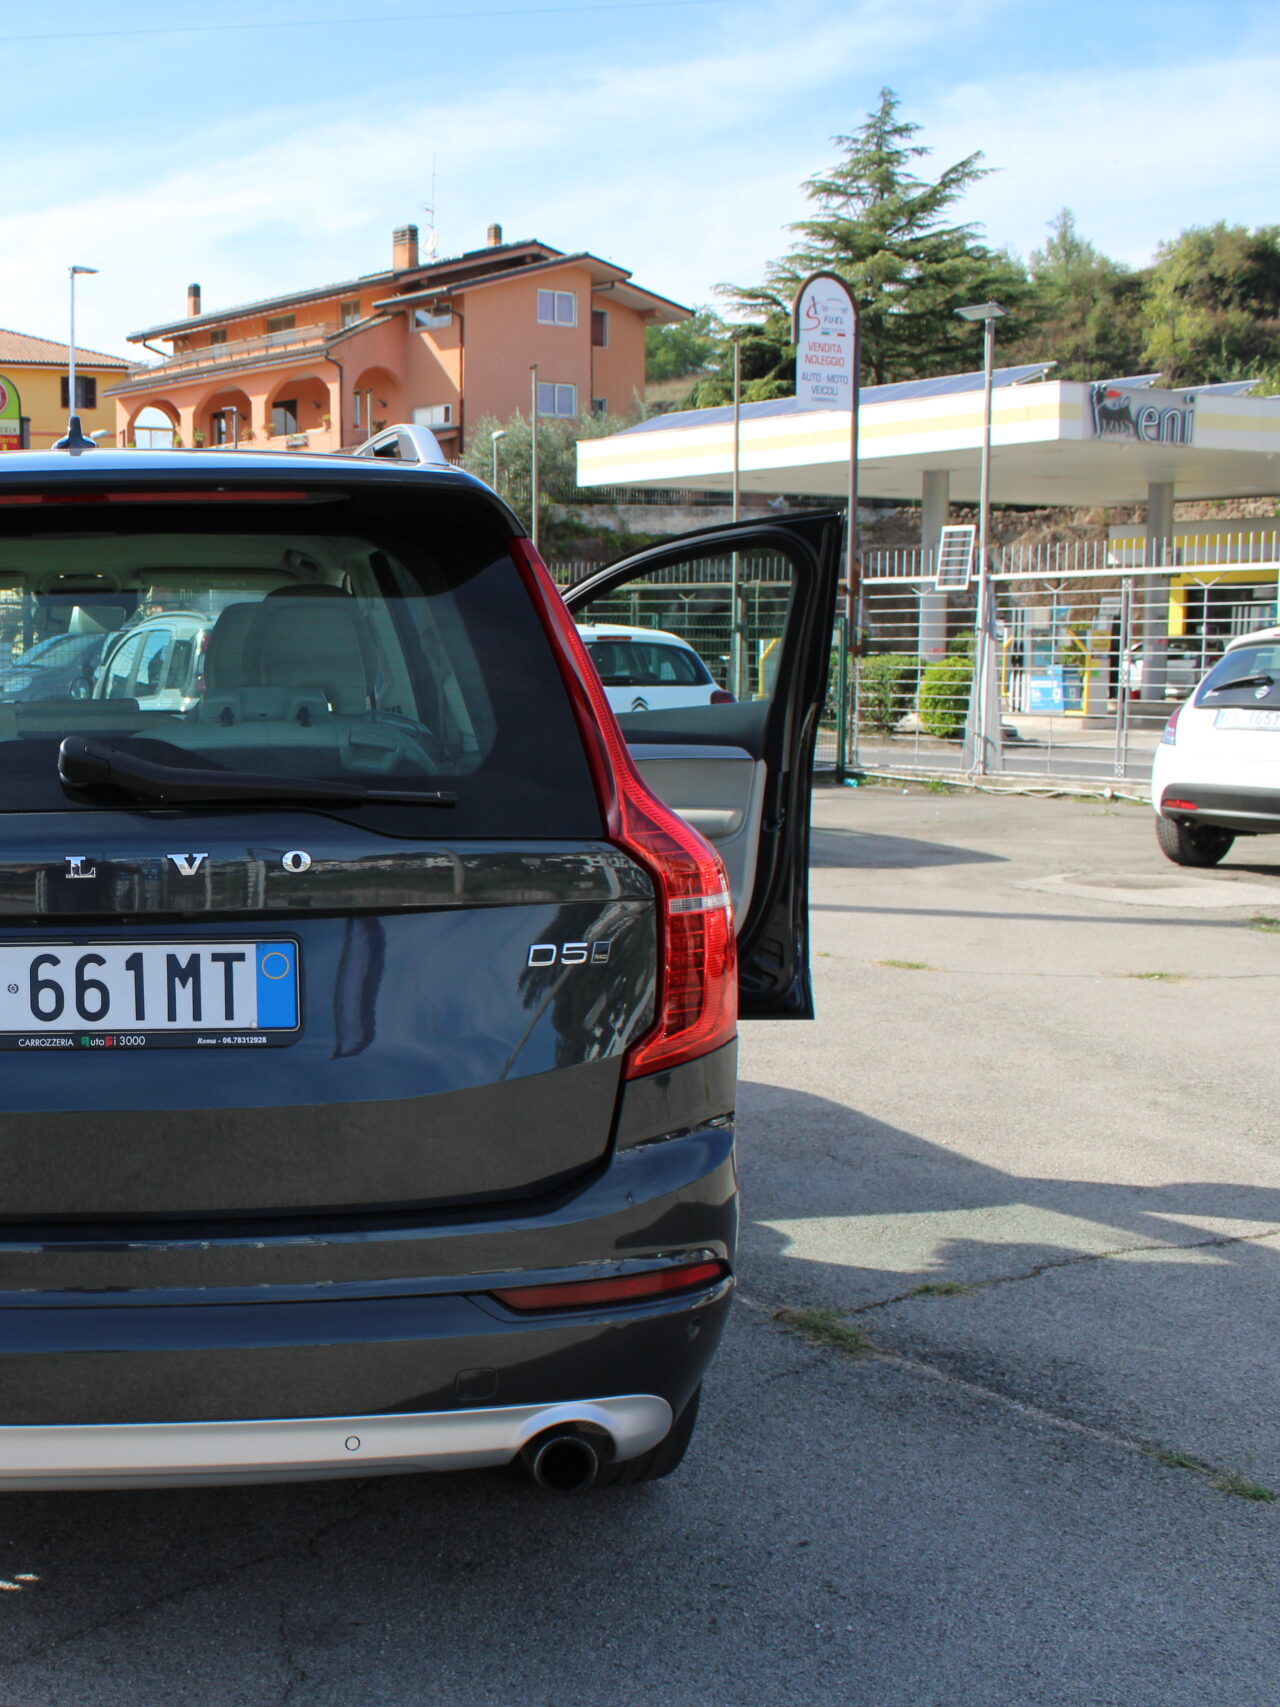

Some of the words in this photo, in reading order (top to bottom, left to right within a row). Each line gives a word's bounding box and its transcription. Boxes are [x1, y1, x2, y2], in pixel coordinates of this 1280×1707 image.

[823, 315, 844, 325] FUEL
[808, 342, 842, 353] VENDITA
[805, 355, 845, 367] NOLEGGIO
[801, 372, 822, 383] AUTO
[827, 374, 849, 384] MOTO
[811, 386, 838, 396] VEICOLI
[1138, 395, 1194, 443] eni
[527, 942, 588, 967] D5
[29, 952, 246, 1023] 661MT
[18, 1038, 74, 1047] CARROZZERIA
[119, 1036, 145, 1046] 3000
[197, 1037, 217, 1045] Roma
[222, 1036, 267, 1045] 06.78312928
